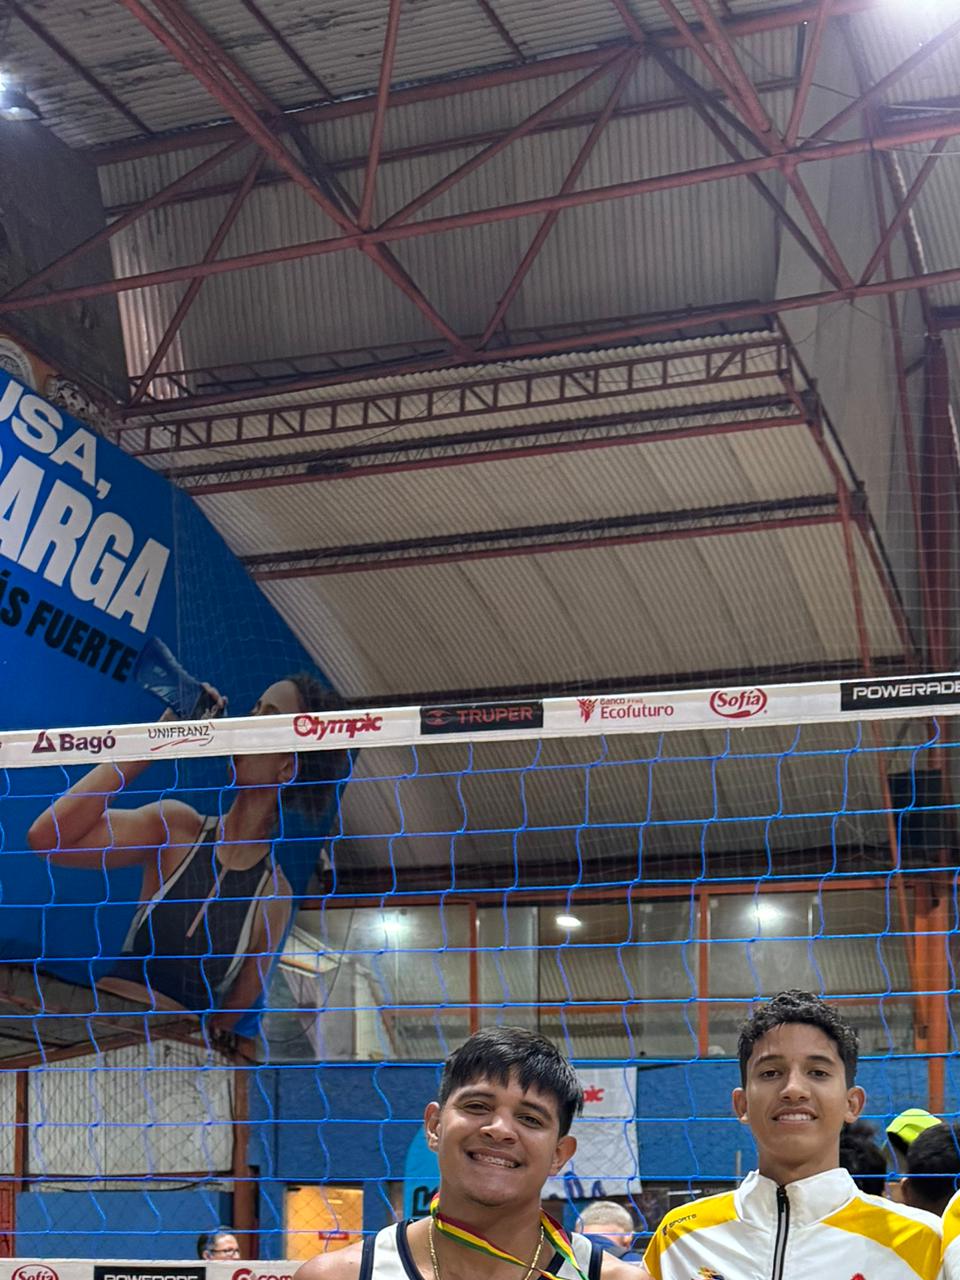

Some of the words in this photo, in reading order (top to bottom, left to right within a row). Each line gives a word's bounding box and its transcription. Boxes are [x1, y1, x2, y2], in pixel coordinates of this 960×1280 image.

[25, 601, 138, 683] FUERTE
[717, 690, 762, 710] Sofía
[456, 705, 535, 724] TRUPER
[600, 703, 674, 720] Ecofuturo
[148, 724, 211, 742] UNIFRANZ
[293, 713, 383, 740] Olympic
[58, 730, 117, 755] Bagó
